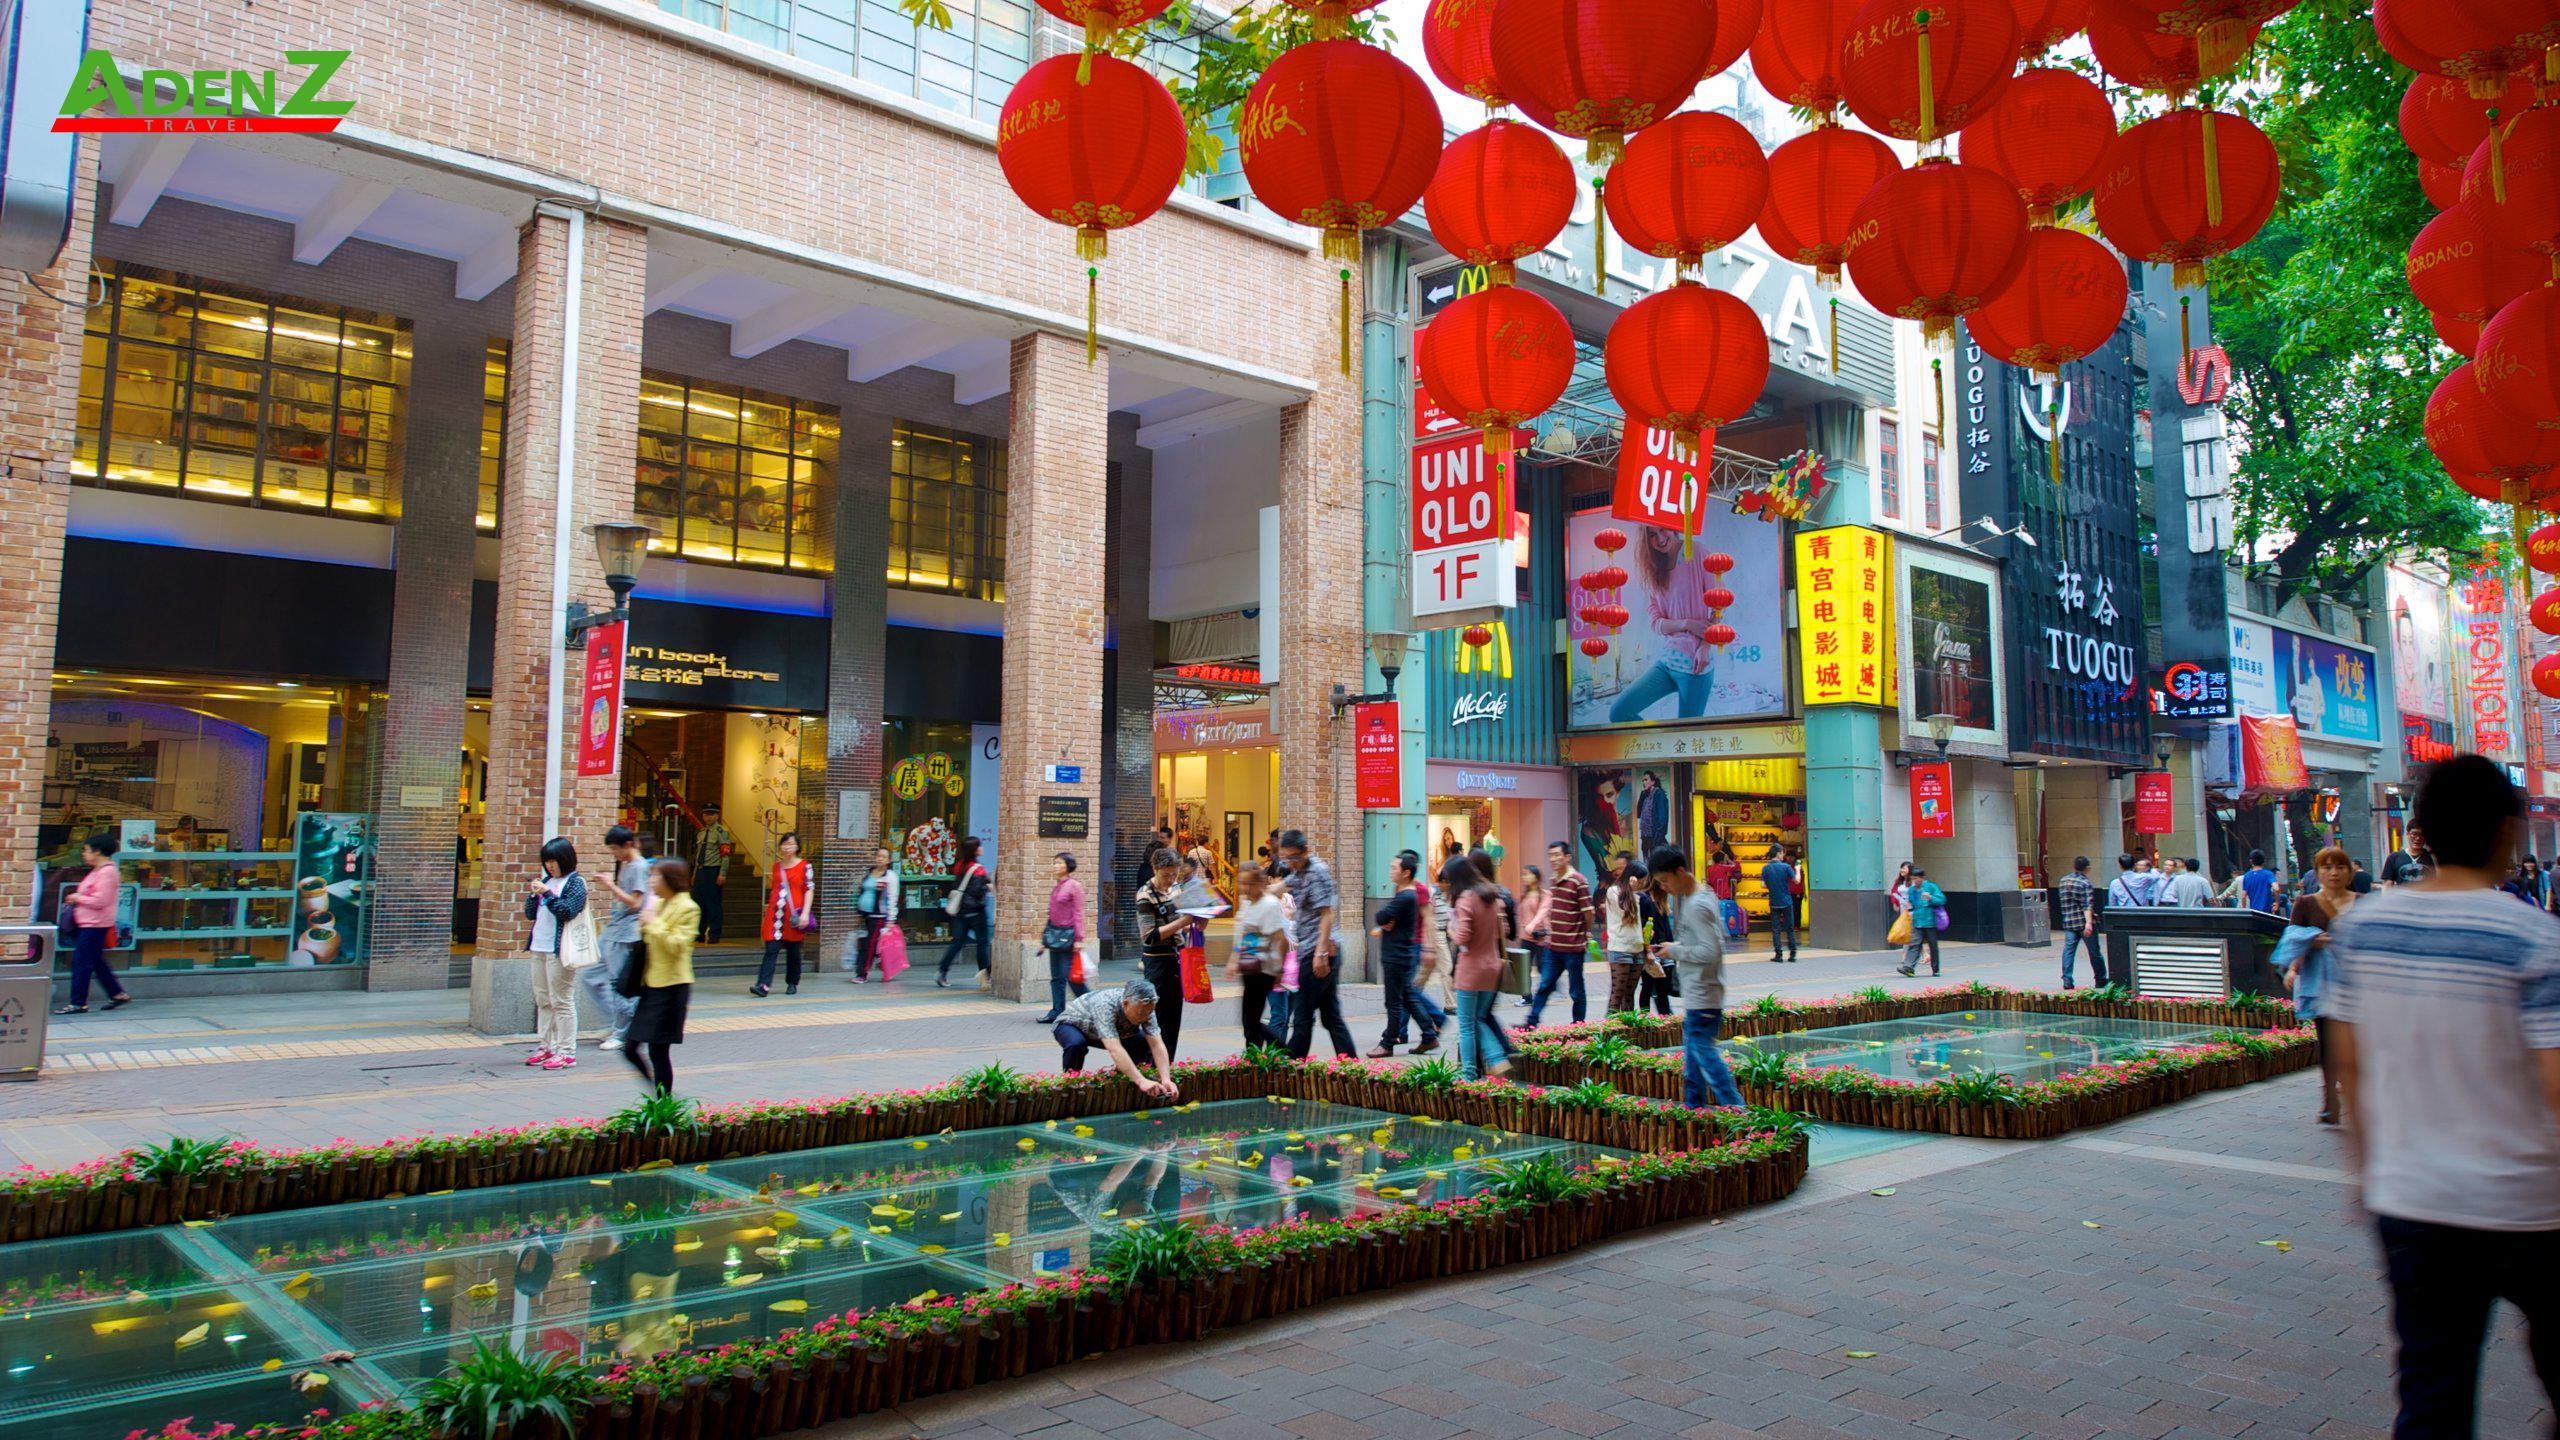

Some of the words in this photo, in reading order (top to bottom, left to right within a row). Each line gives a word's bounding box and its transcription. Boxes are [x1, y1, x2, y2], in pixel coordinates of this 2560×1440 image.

[1965, 329, 1985, 424] UOGU
[1421, 444, 1484, 492] UNI
[1967, 428, 1991, 474] 拓谷
[1421, 490, 1492, 544] QLO
[1640, 465, 1699, 516] QLO
[1432, 553, 1480, 602] 1F
[2057, 560, 2119, 627] 拓谷
[1808, 535, 1842, 688] 青宫电影城
[1859, 535, 1877, 688] 青宫电影城
[2042, 627, 2134, 686] TUOGU
[2469, 621, 2509, 753] BONJOUR
